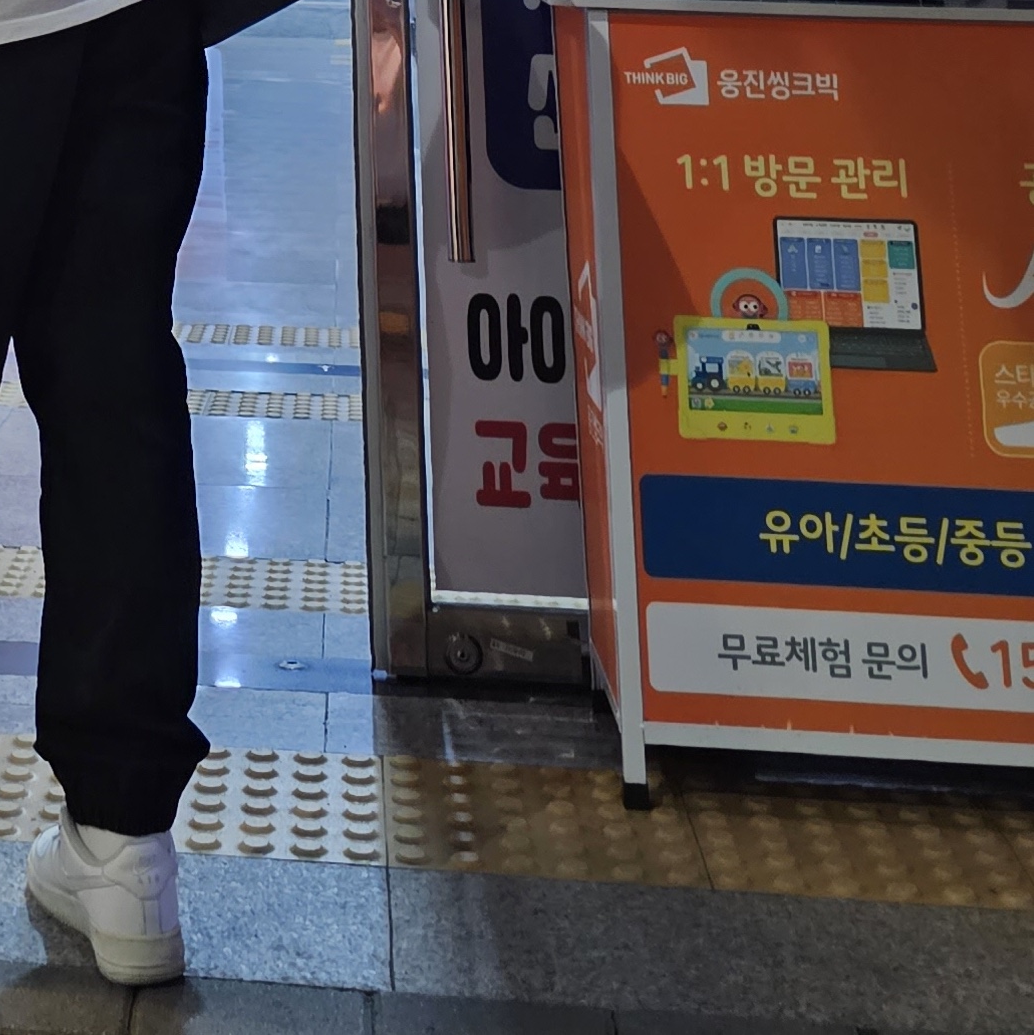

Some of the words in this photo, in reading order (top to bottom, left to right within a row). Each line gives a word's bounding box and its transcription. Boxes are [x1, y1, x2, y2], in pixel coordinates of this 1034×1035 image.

[623, 71, 665, 86] THINK
[666, 72, 688, 86] BIG
[717, 68, 839, 101] 웅진씽크빅
[677, 153, 730, 191] 1:1
[744, 153, 822, 199] 방문
[830, 156, 909, 199] 관리
[717, 633, 852, 679] 무료체험
[861, 642, 928, 680] 문의
